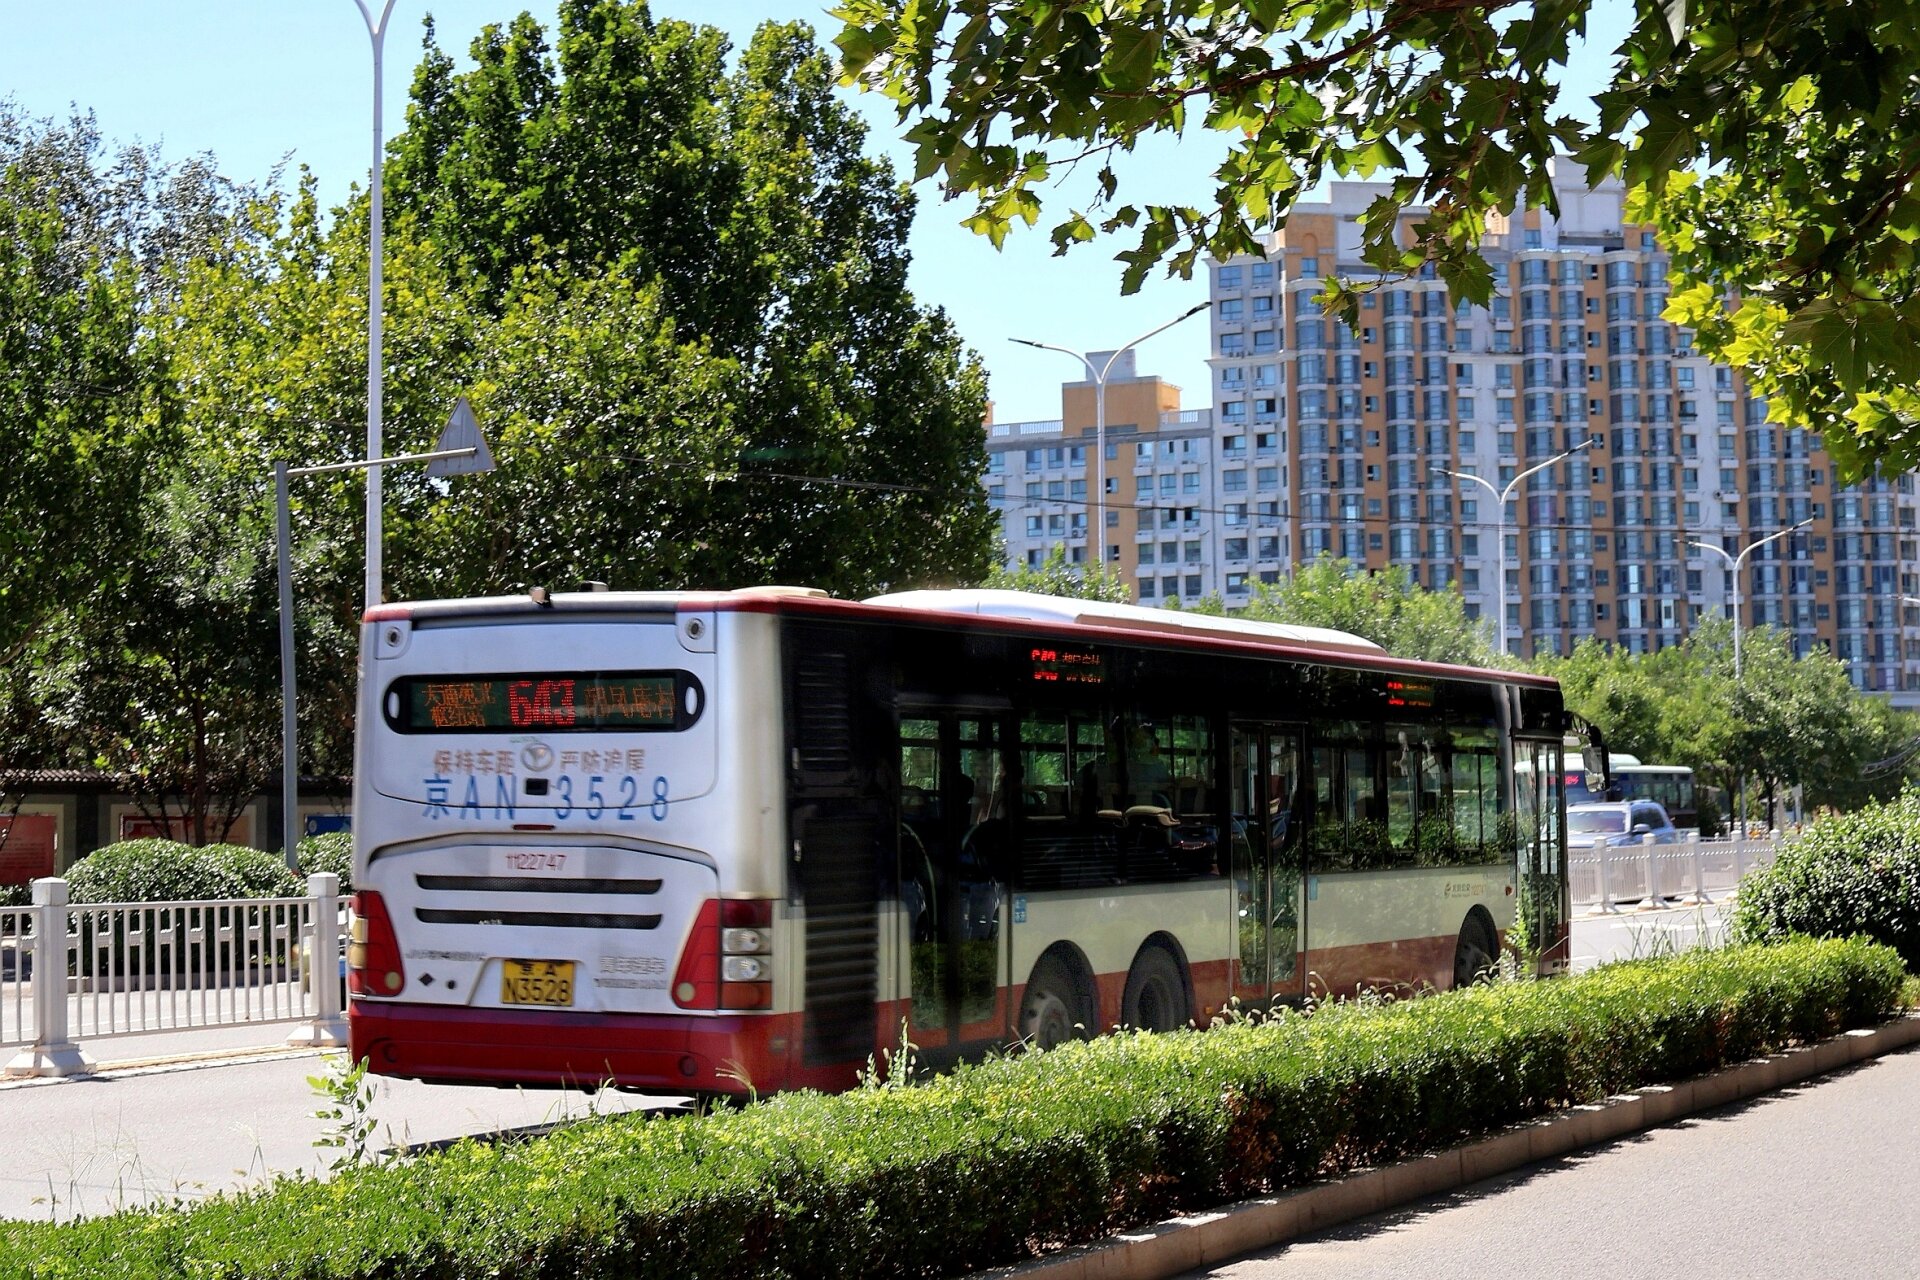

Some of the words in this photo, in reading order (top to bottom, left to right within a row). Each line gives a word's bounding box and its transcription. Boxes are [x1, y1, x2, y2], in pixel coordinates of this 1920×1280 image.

[508, 679, 576, 727] 643
[433, 749, 516, 776] 保持车距
[560, 748, 646, 775] 严防追尾
[421, 772, 518, 821] 京AN
[555, 775, 670, 822] 3528
[505, 853, 568, 872] 1122747
[503, 977, 570, 1004] N3528
